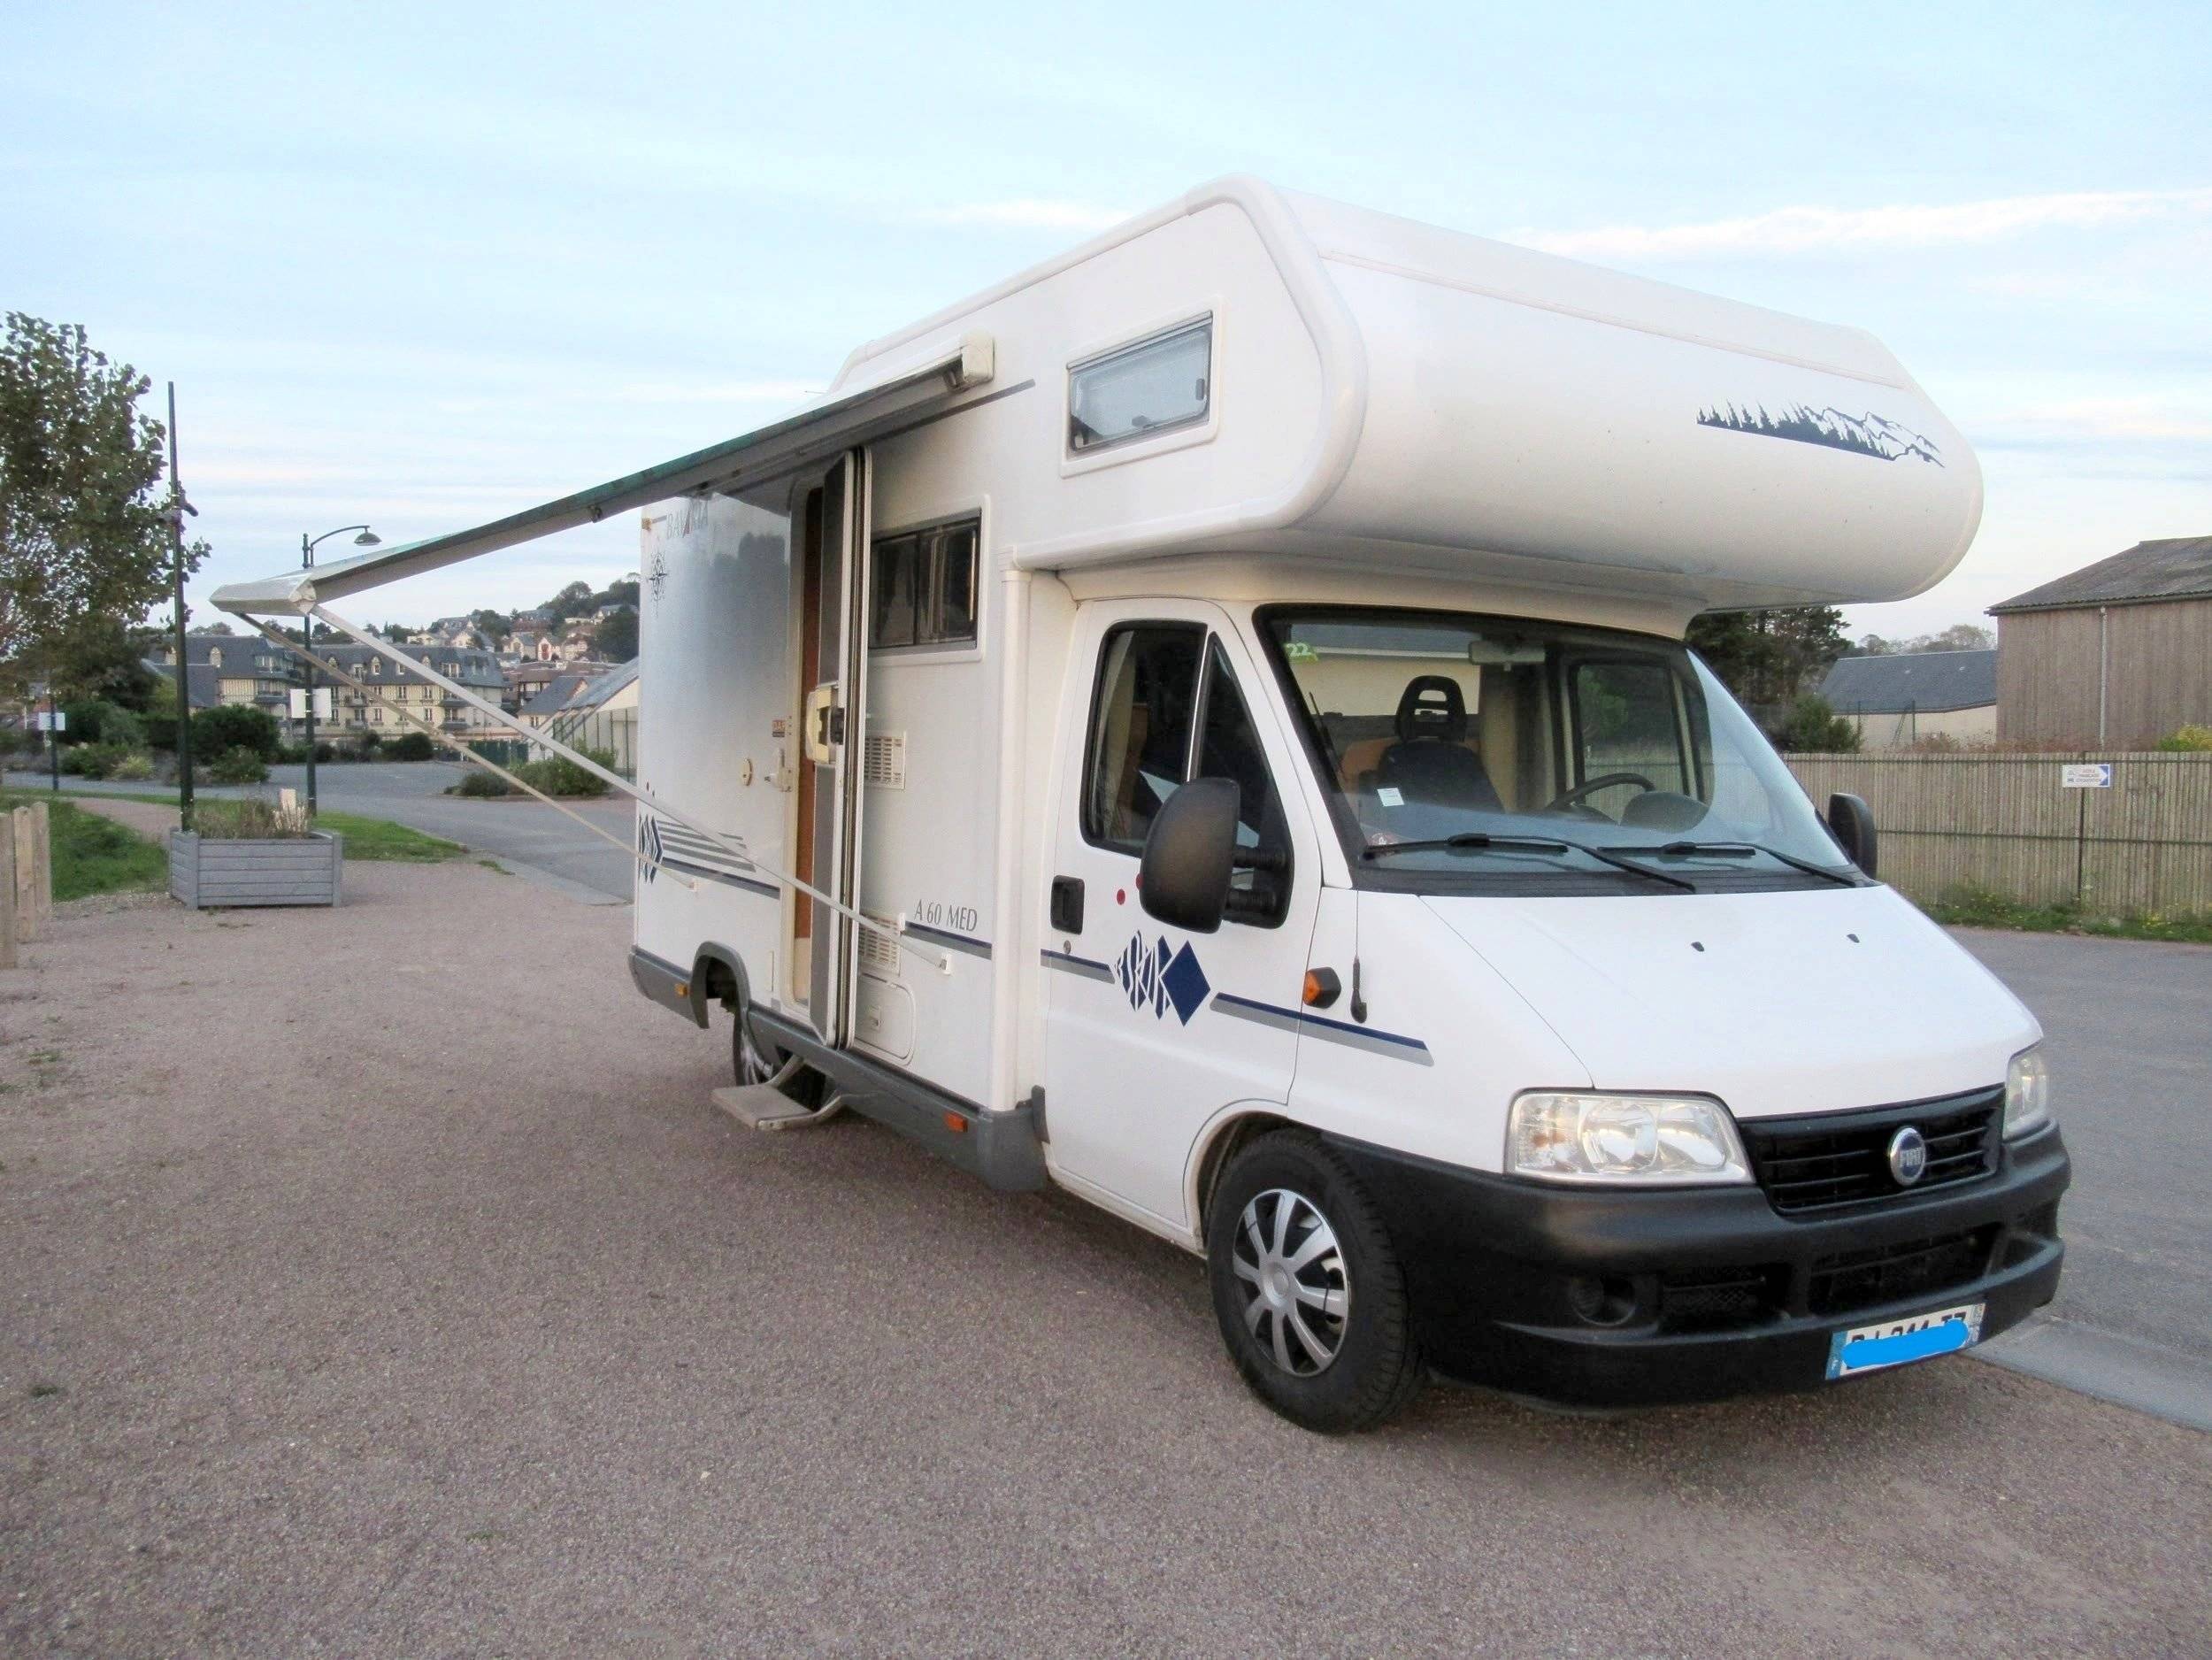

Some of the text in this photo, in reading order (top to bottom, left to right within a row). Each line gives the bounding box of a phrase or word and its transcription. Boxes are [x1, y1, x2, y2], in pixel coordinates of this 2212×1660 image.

[914, 898, 978, 932] A 60 MED
